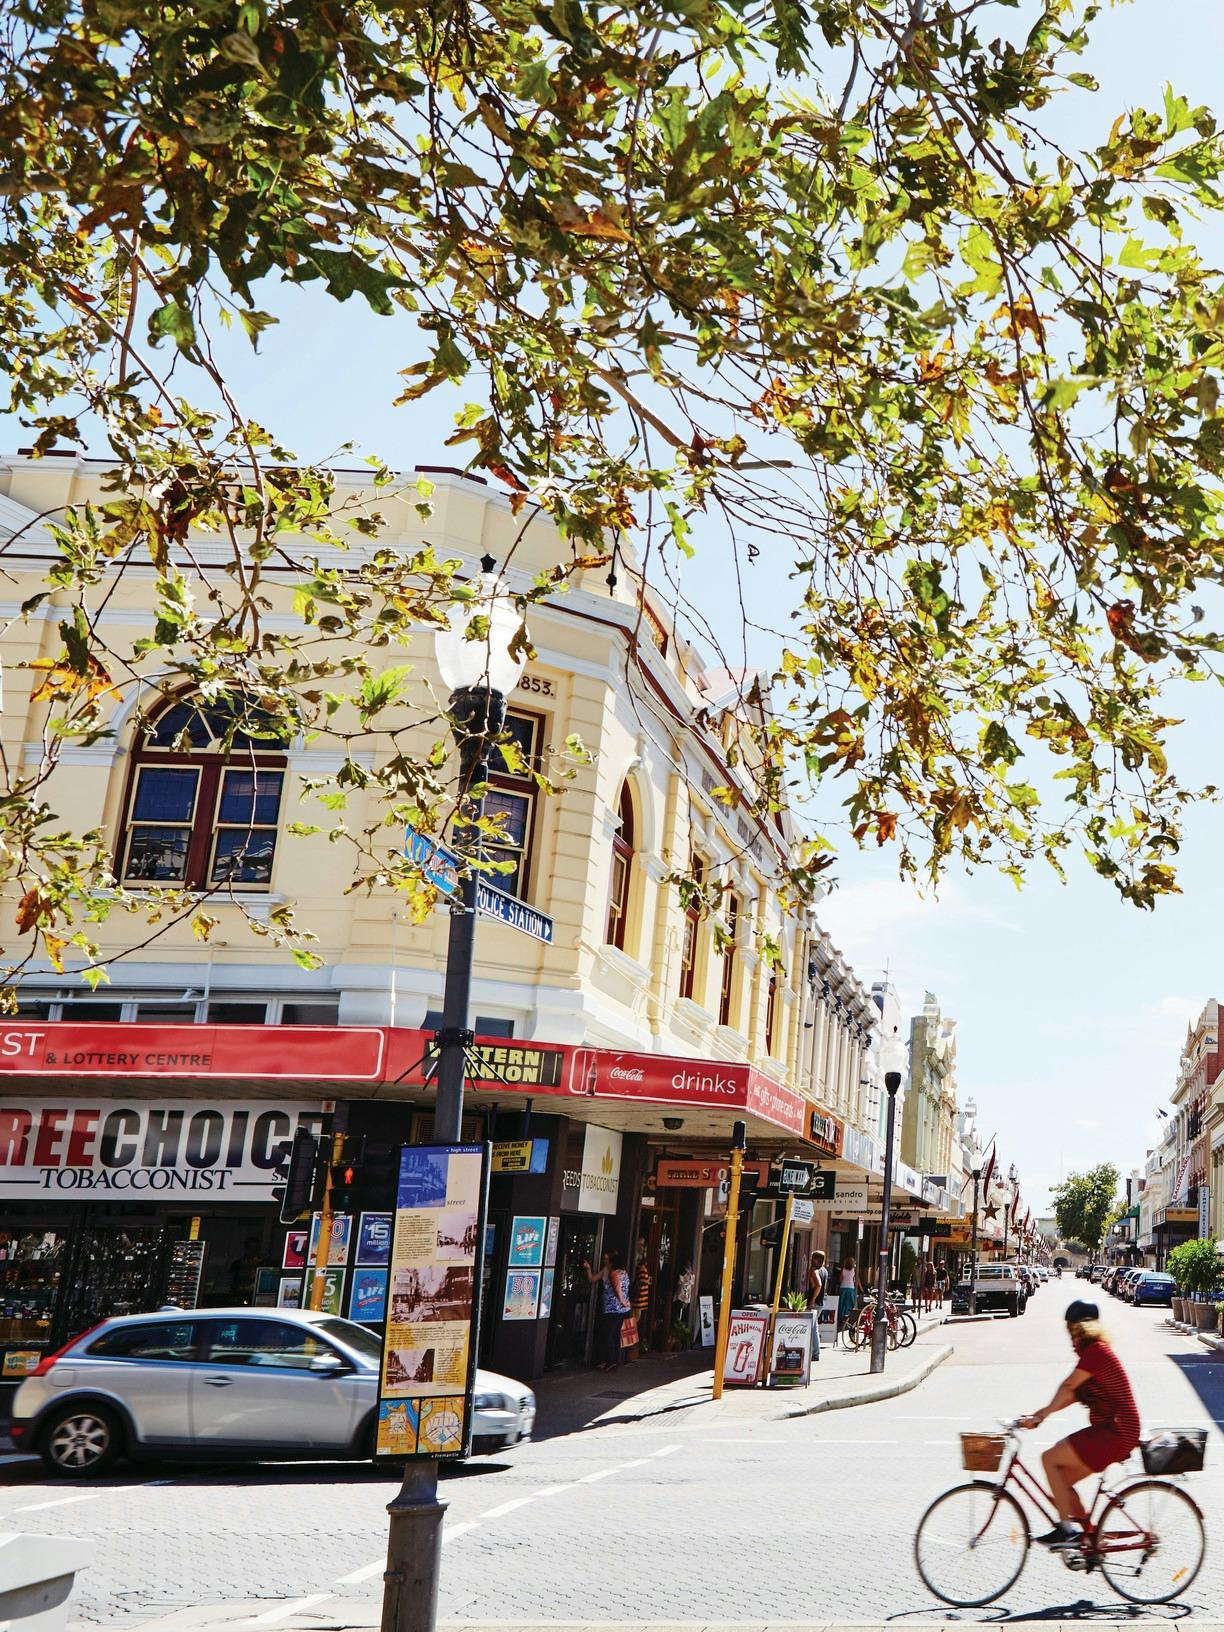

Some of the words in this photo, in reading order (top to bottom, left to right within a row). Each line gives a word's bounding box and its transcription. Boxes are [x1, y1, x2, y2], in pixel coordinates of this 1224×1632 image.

[508, 902, 543, 936] STATION
[0, 1032, 45, 1056] ST
[428, 1042, 540, 1066] WSTERN
[46, 1052, 57, 1065] &
[64, 1052, 140, 1065] LOTTERY
[145, 1053, 212, 1066] CENTRE
[671, 1070, 737, 1095] drinks
[40, 1167, 232, 1190] TOBACCONIST
[512, 1276, 534, 1294] 30
